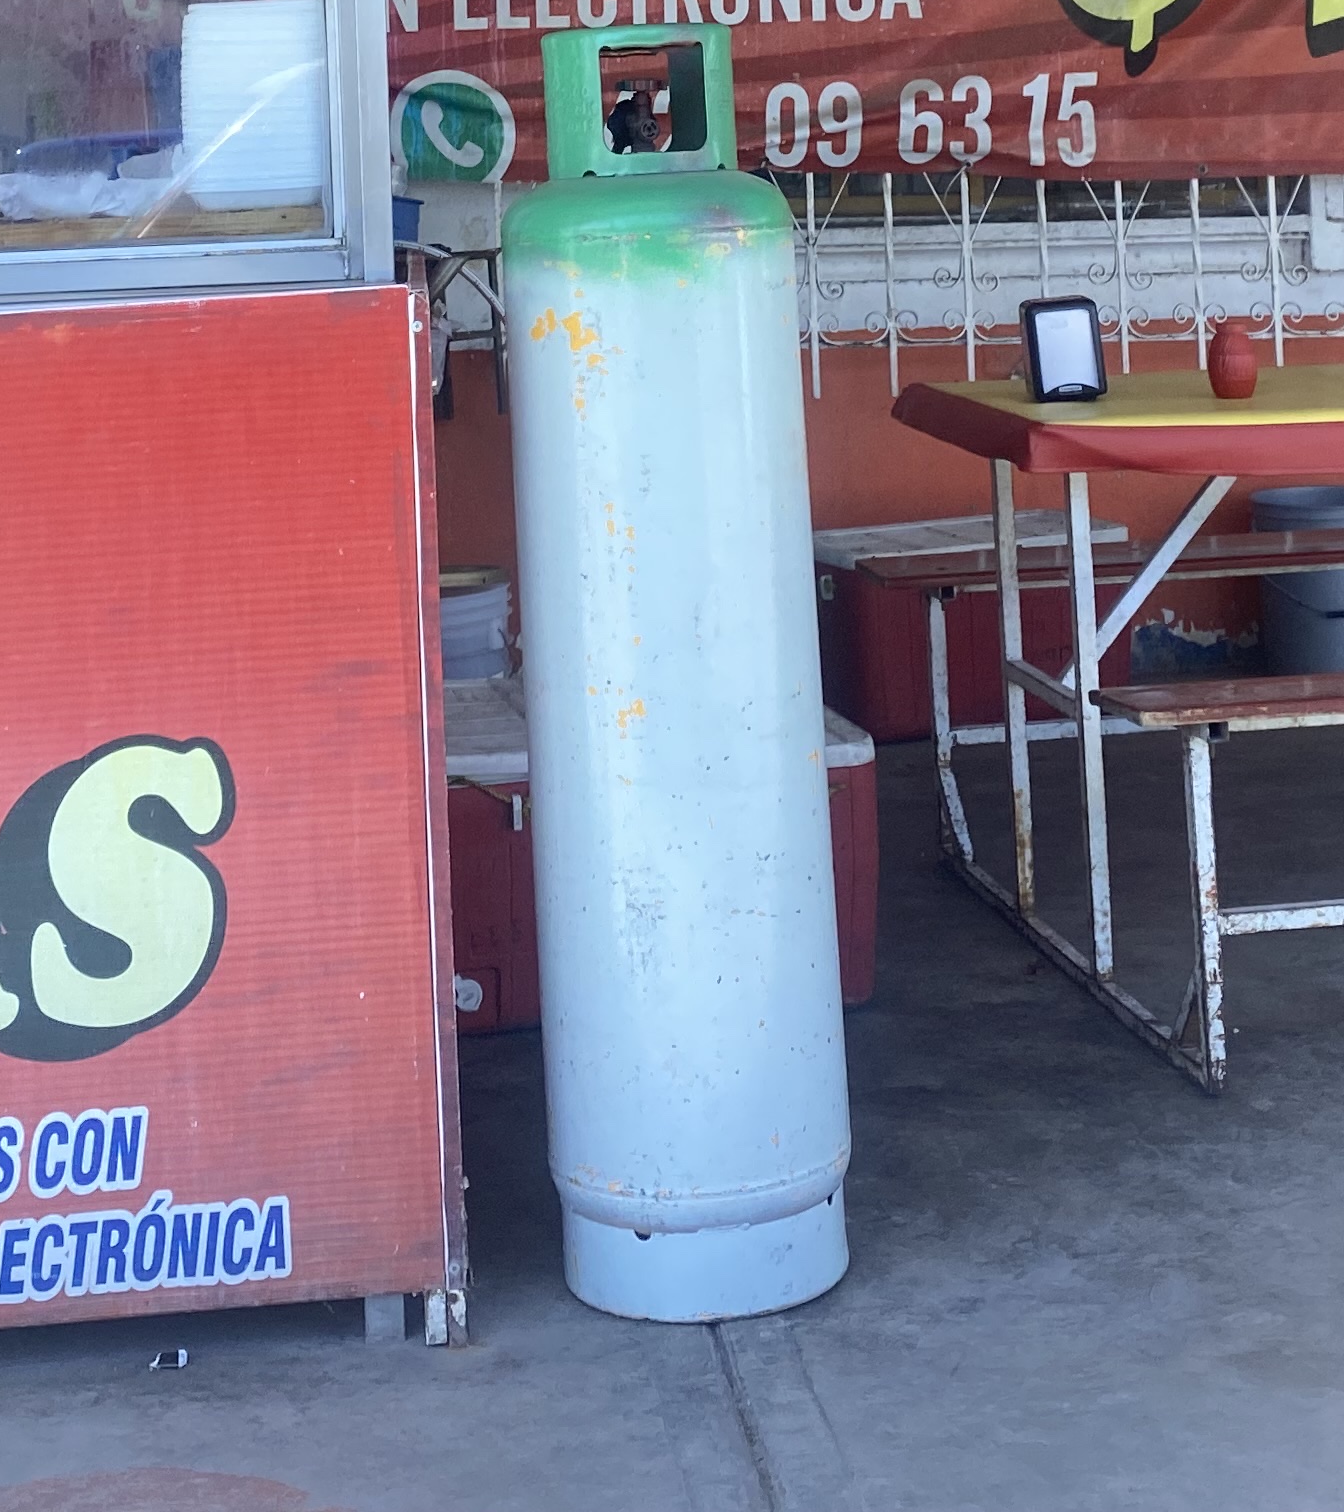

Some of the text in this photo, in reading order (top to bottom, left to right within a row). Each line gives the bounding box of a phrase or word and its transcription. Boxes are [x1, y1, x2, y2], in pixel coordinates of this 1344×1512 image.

[764, 72, 1099, 169] 09 63 15
[34, 1116, 141, 1190] CON
